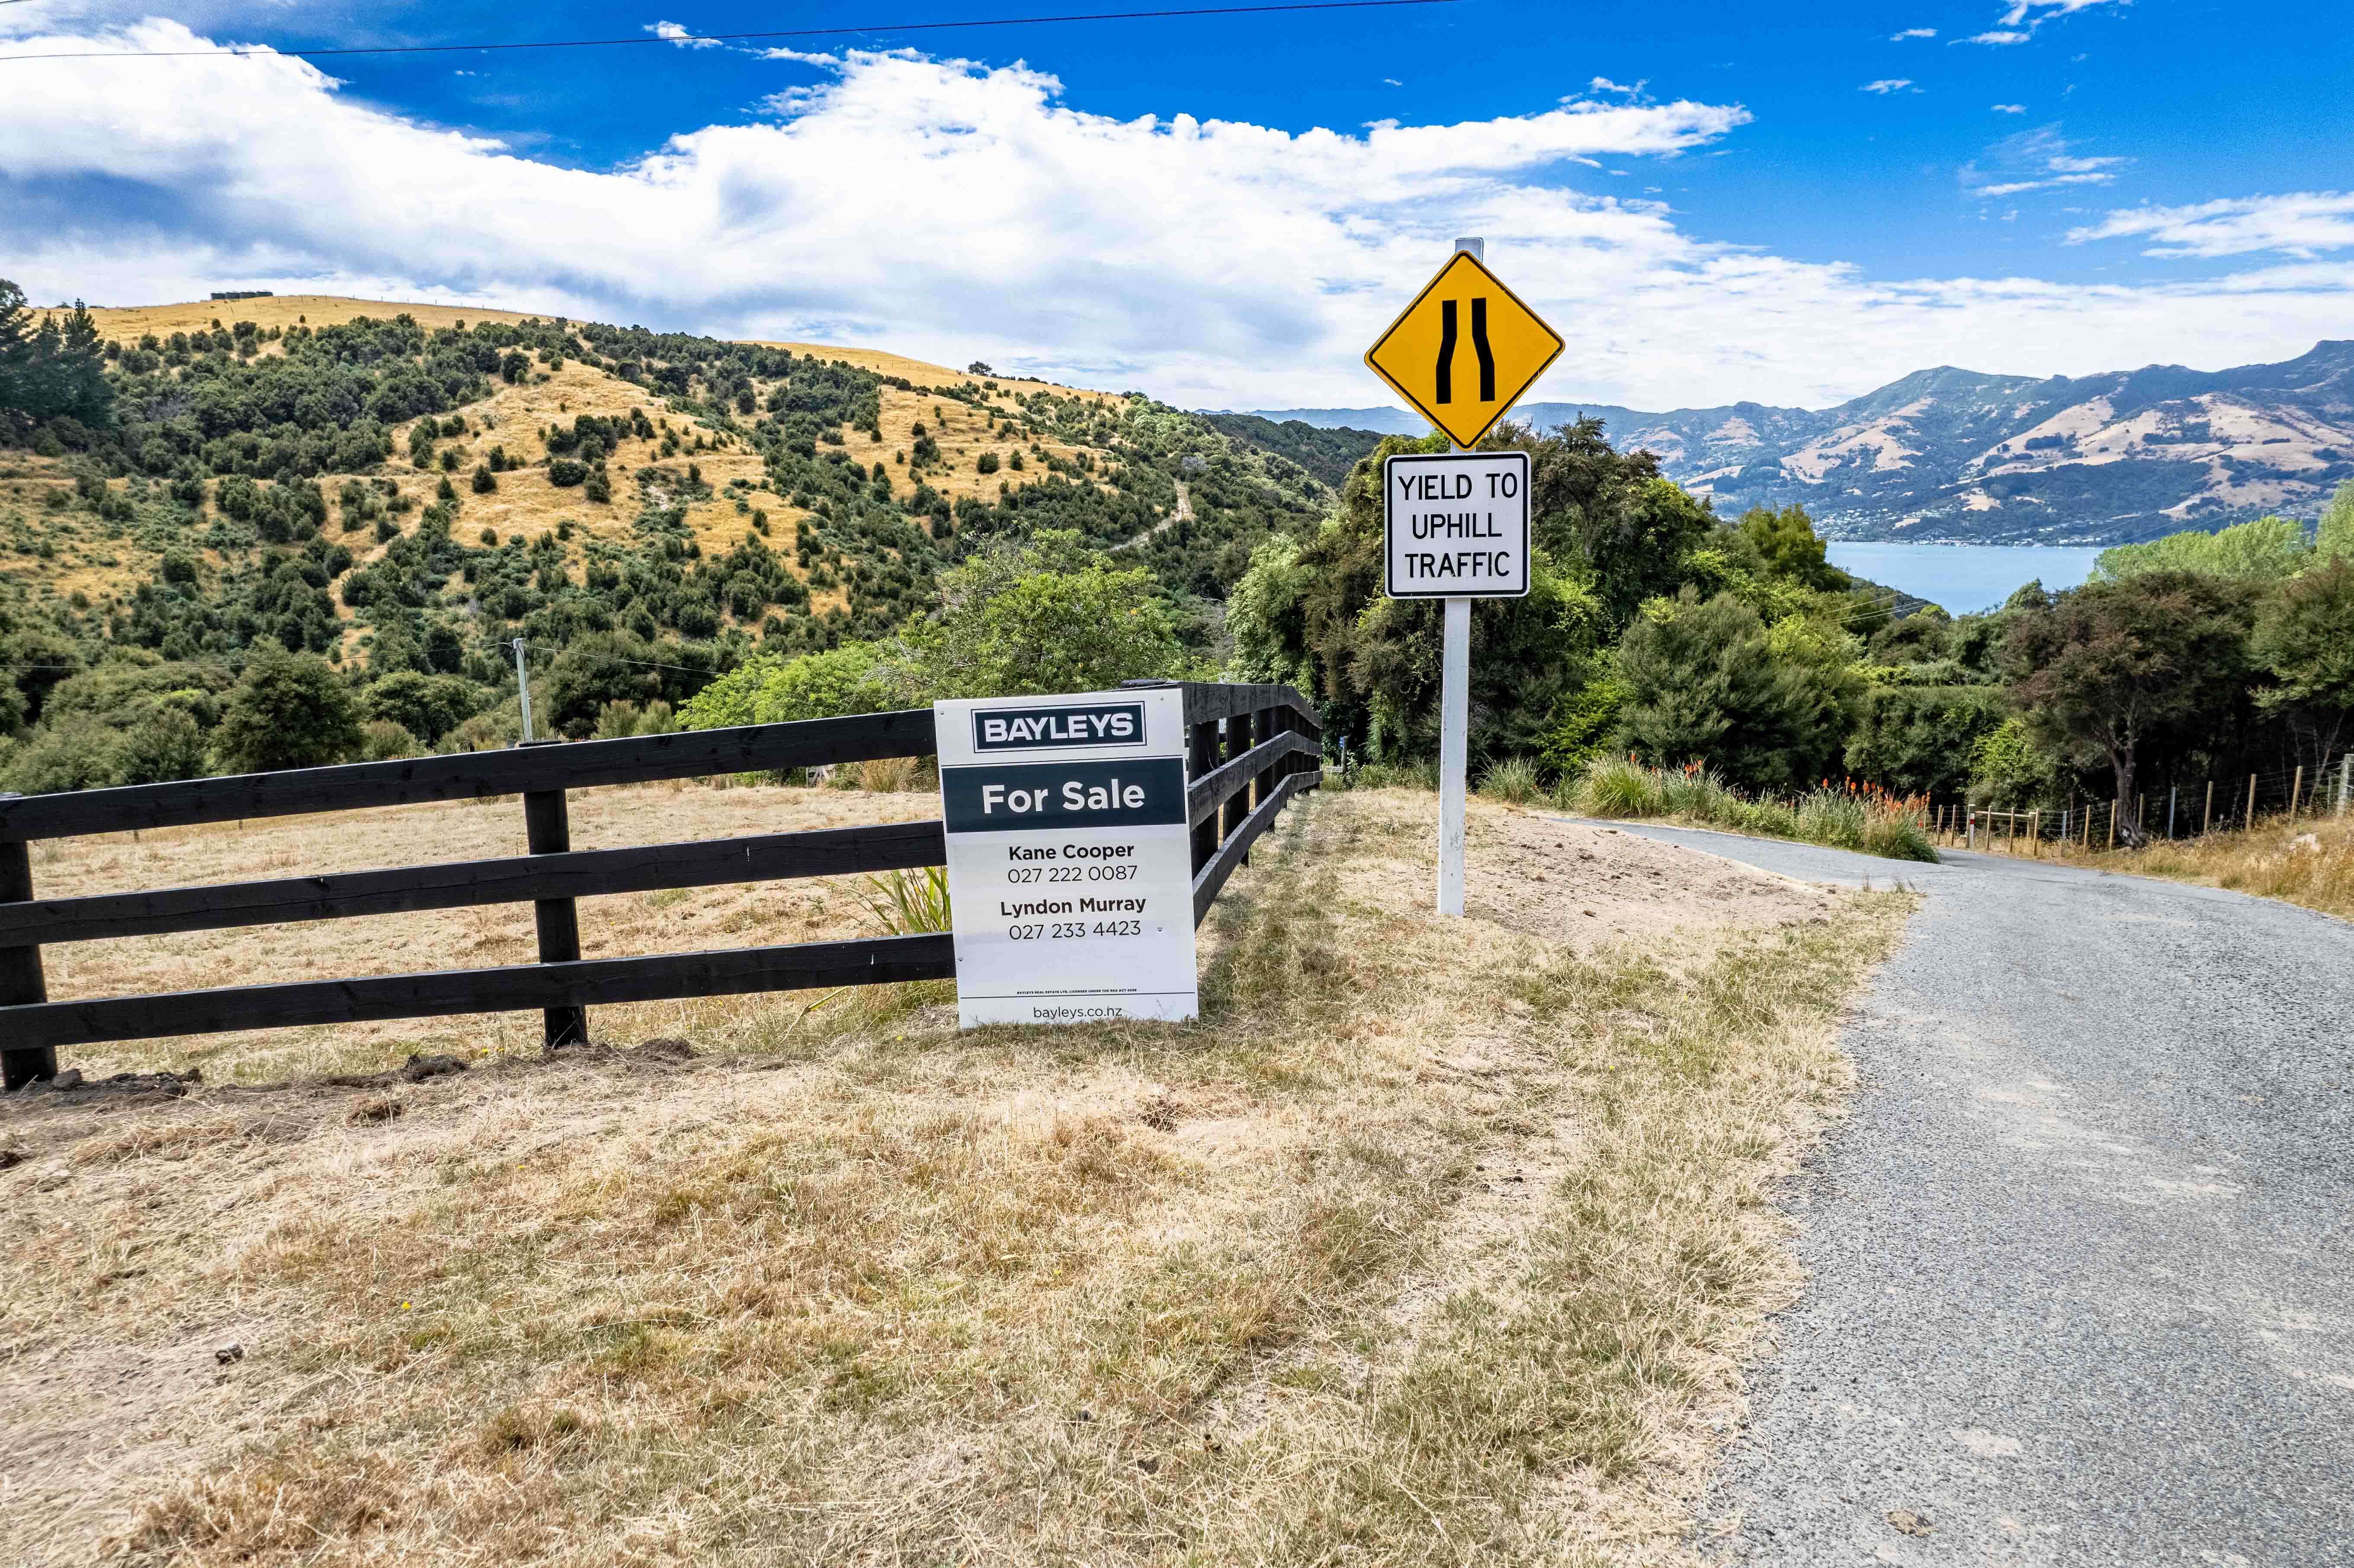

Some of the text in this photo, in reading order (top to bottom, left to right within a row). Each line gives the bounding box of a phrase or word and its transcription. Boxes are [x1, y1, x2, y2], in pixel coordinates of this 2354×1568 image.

[1398, 472, 1518, 501] YIELD TO
[1412, 513, 1502, 539] UPHILL
[1405, 551, 1511, 578] TRAFFIC
[984, 712, 1134, 743] BAYLEYS
[982, 778, 1145, 814] For Sale
[1009, 844, 1135, 860] Kane Cooper
[1008, 865, 1138, 883] 027 222 0087
[1001, 898, 1146, 918] Lyndon Murray
[1009, 920, 1141, 940] 027 233 4423
